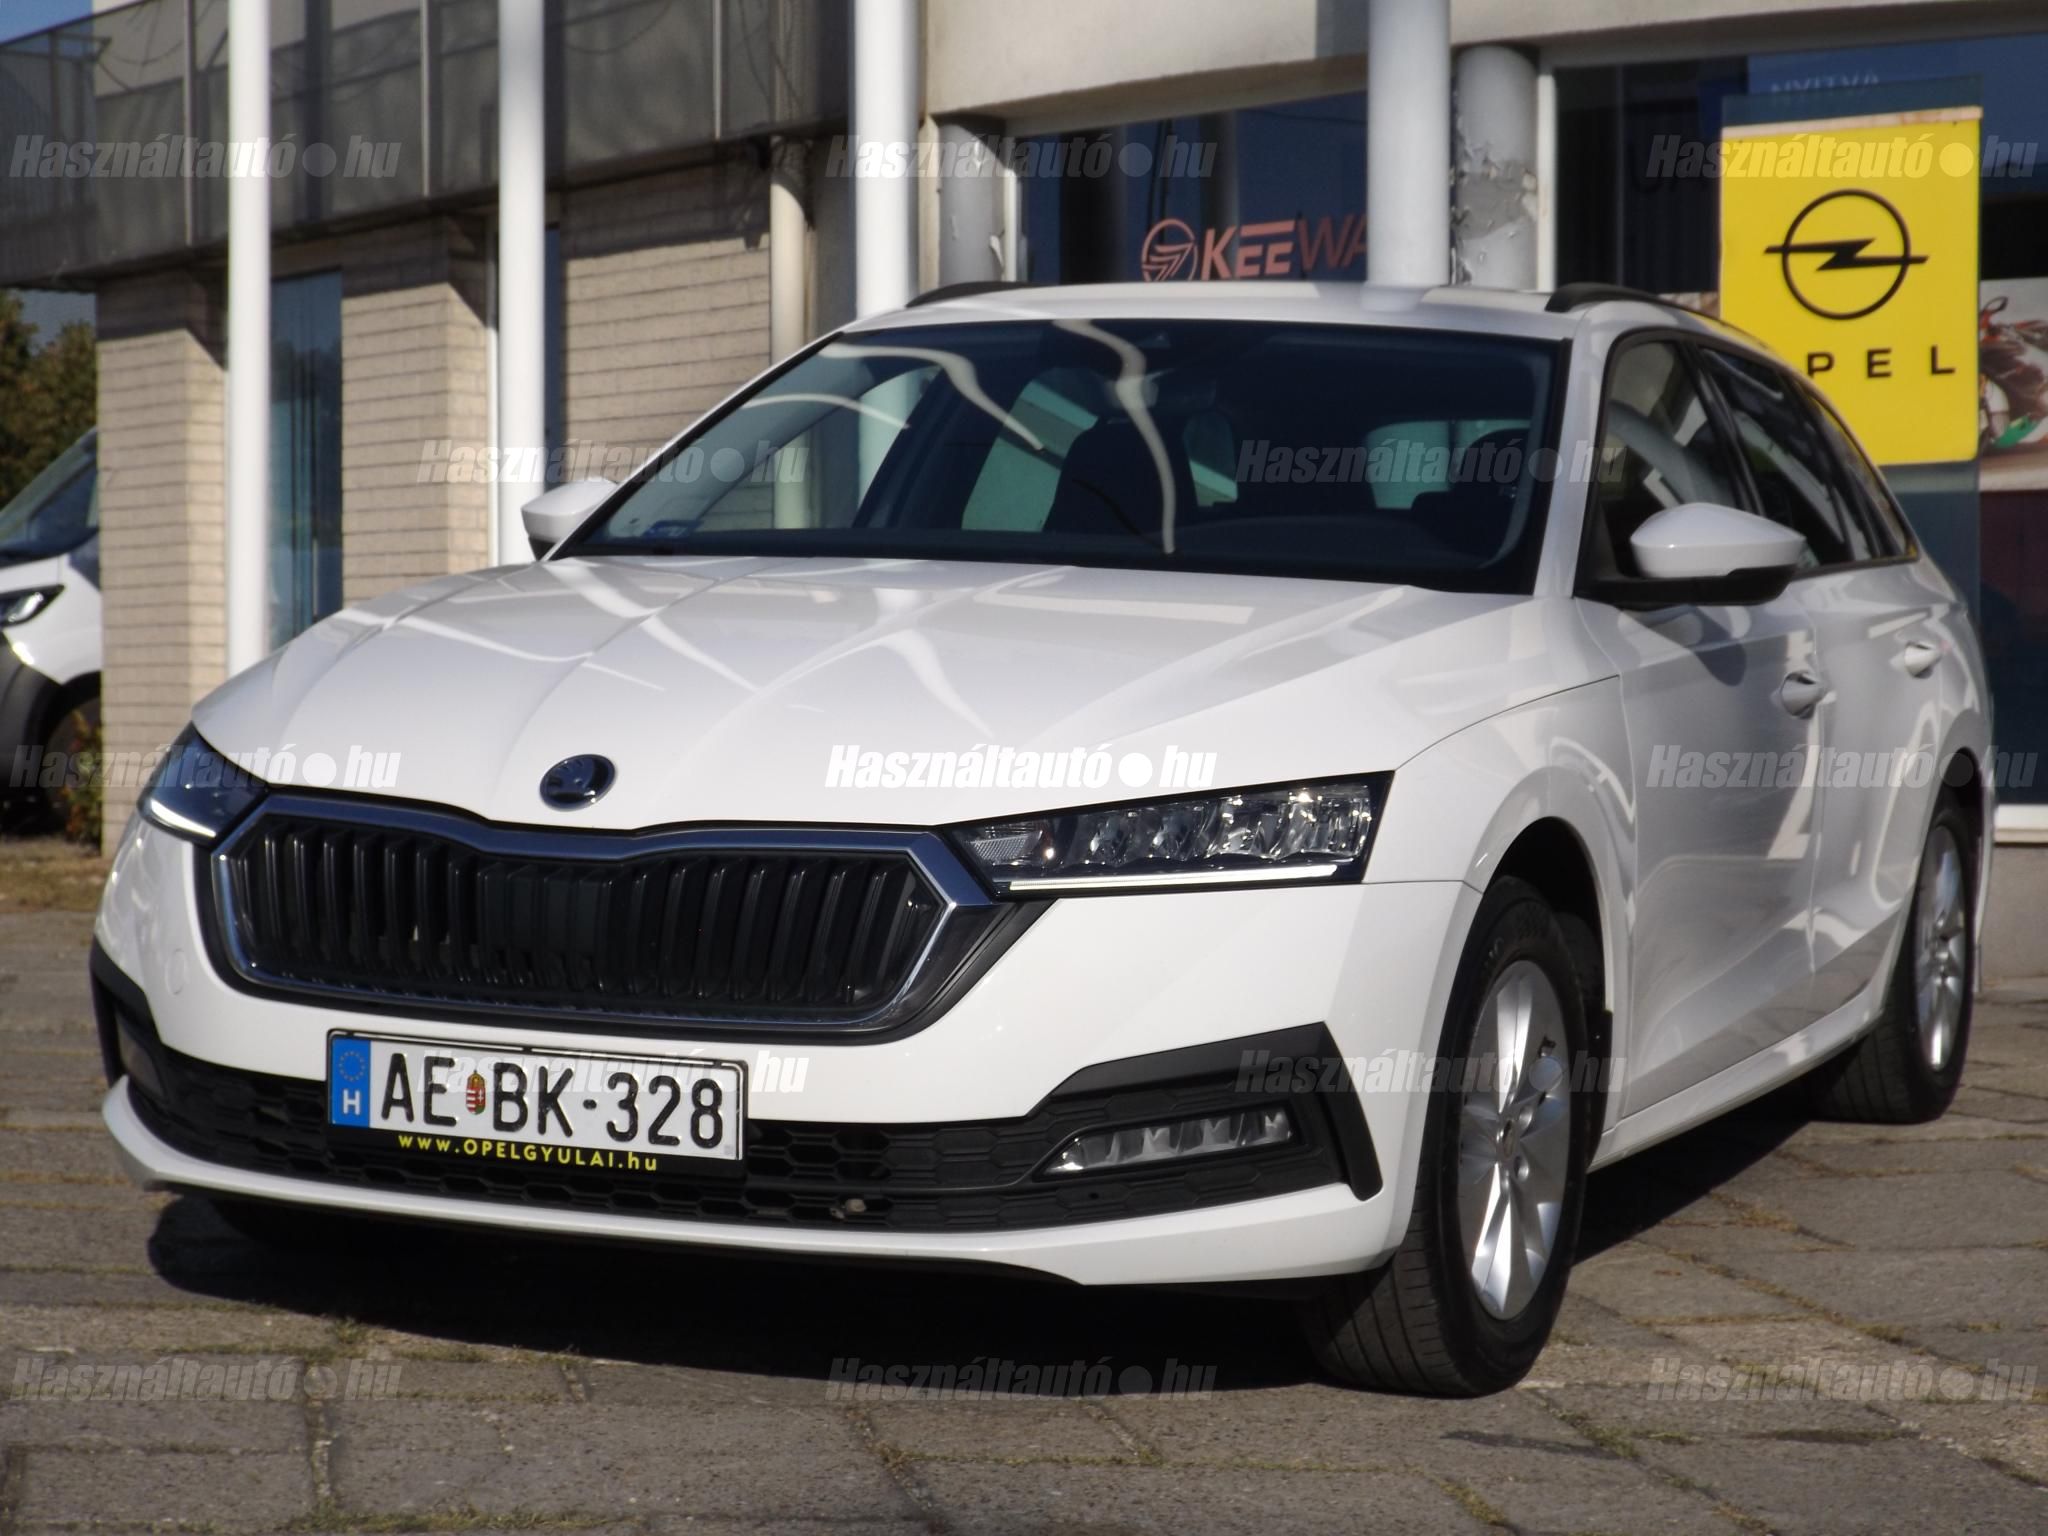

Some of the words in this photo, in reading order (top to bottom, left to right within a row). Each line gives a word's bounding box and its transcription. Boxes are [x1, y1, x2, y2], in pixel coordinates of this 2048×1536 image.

[1201, 214, 1368, 280] KEEWA
[1807, 345, 1956, 378] PEL
[342, 1089, 361, 1116] H
[381, 1053, 457, 1126] AE
[398, 1134, 658, 1172] www.OPELGYULAI.hu
